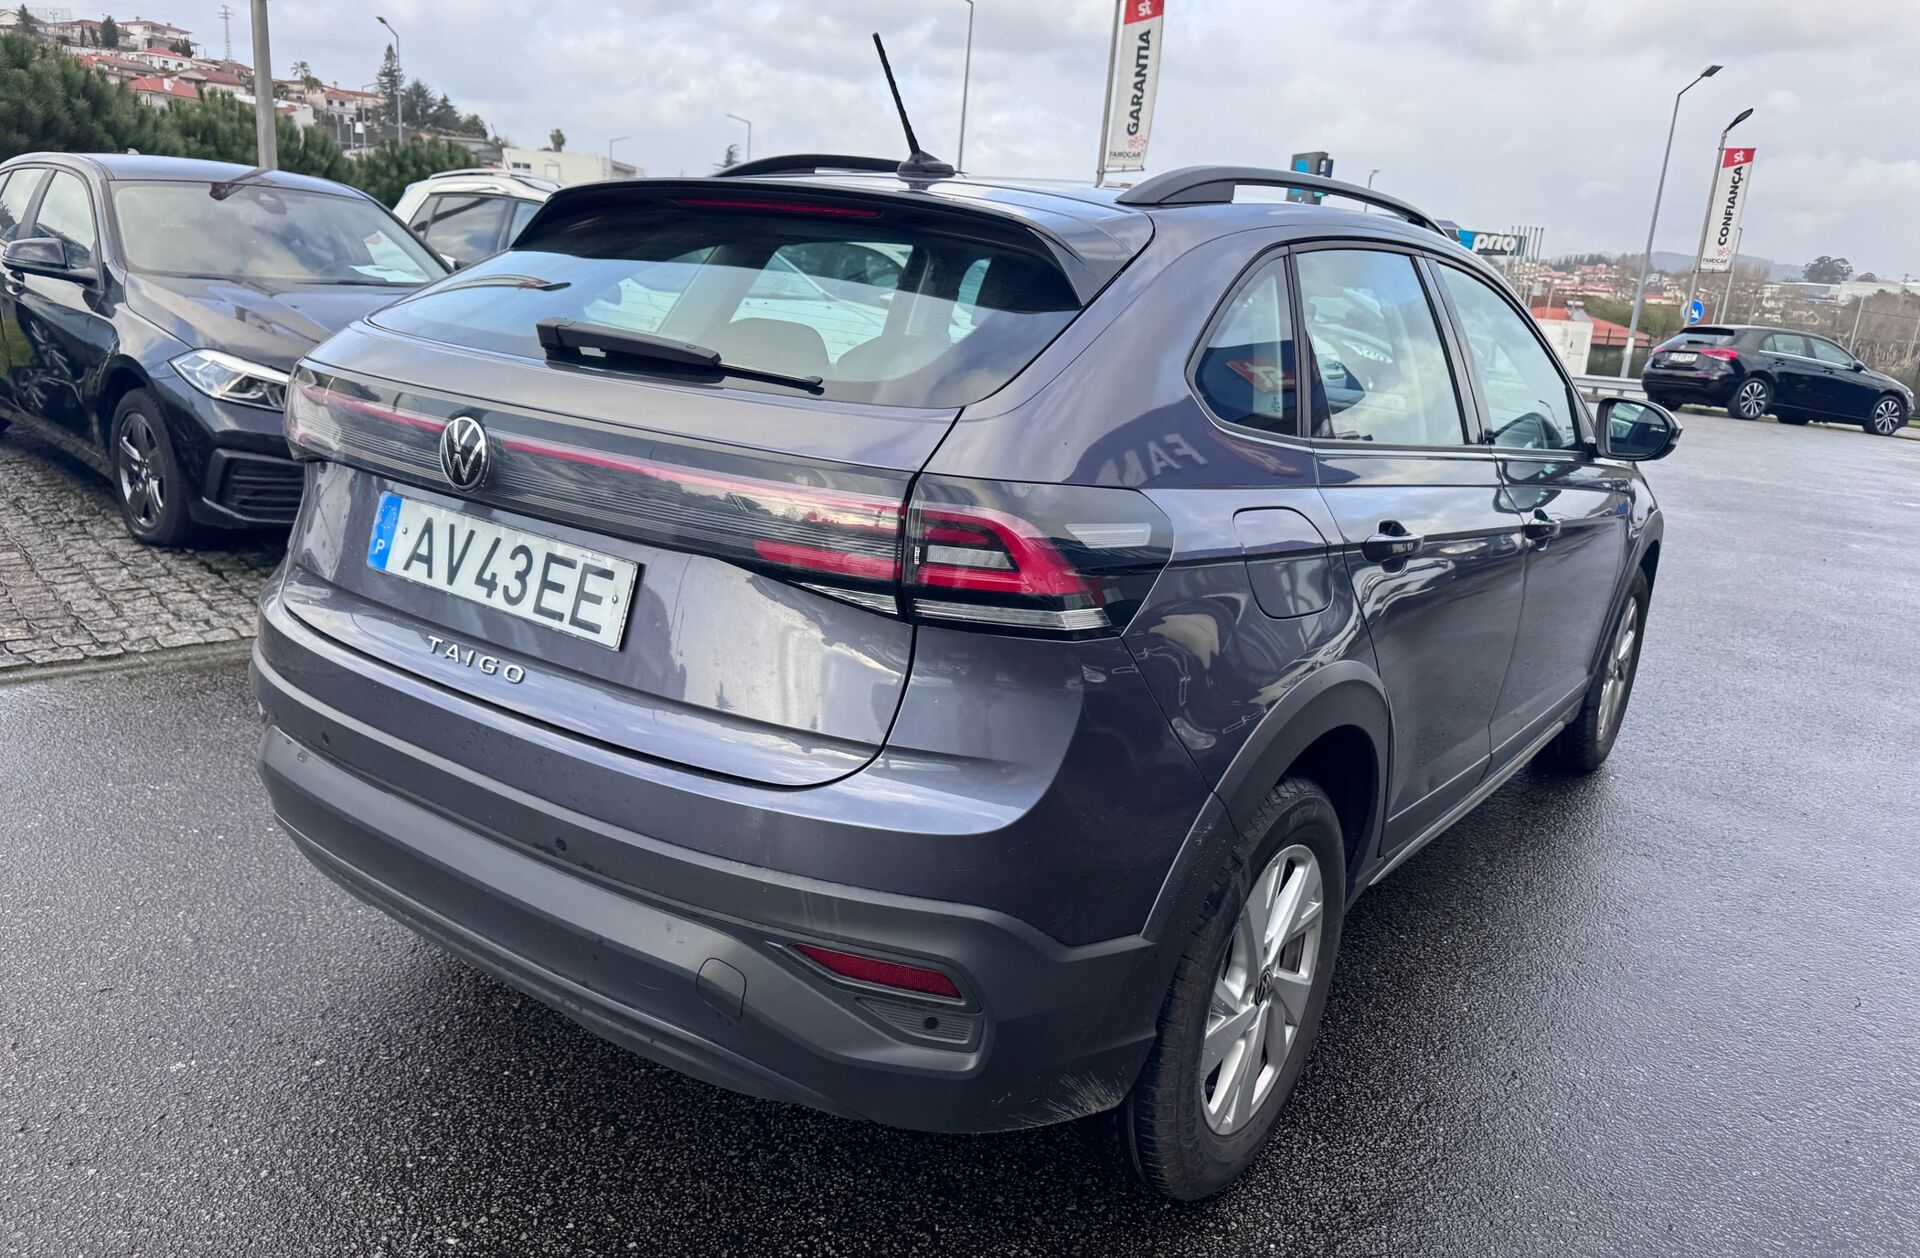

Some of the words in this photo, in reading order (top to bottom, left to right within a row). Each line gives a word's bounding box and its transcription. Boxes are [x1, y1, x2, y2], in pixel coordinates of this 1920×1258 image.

[1127, 28, 1151, 136] GARANTIA
[1717, 165, 1743, 246] CONFIANÇA
[1472, 230, 1516, 252] prio
[374, 538, 386, 555] P
[427, 635, 526, 684] TAIGO
